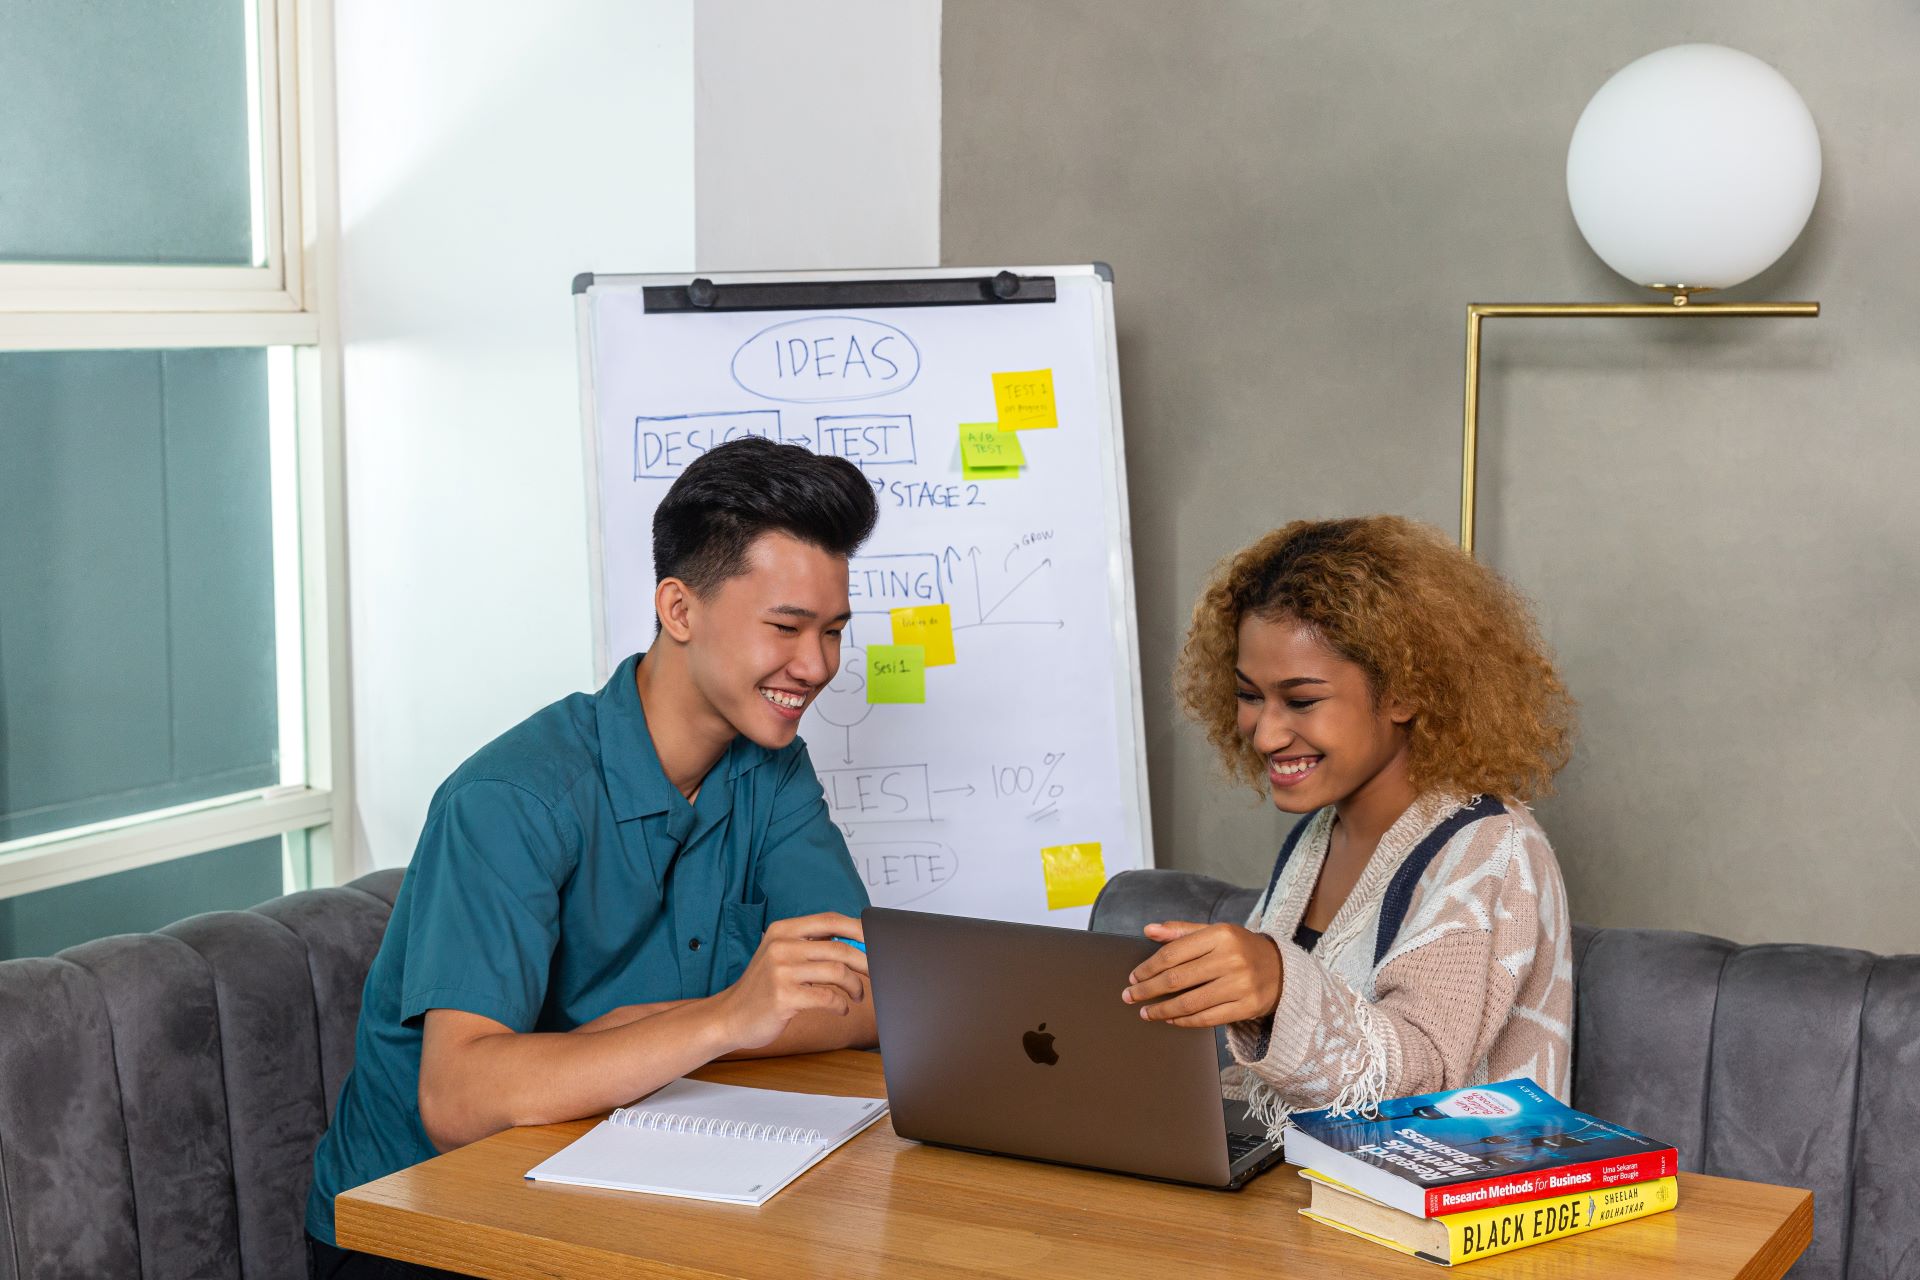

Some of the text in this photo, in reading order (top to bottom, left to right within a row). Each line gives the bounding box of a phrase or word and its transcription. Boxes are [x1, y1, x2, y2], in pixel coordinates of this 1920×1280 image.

[776, 335, 898, 380] IDEAS
[1005, 384, 1036, 399] TEST
[824, 426, 900, 456] TEST
[890, 481, 985, 507] STAGE 2
[1021, 529, 1054, 546] GROW
[848, 569, 932, 599] ETING
[899, 659, 911, 673] 1
[991, 752, 1066, 806] 100%
[853, 855, 944, 887] LETE
[1517, 1085, 1544, 1103] WILEY
[1383, 1139, 1476, 1177] Methods
[1394, 1128, 1483, 1164] Business
[1358, 1144, 1449, 1181] Research
[1617, 1163, 1638, 1173] Sekaran
[1442, 1172, 1592, 1206] Research Methods for Business
[1602, 1174, 1619, 1183] Roger
[1600, 1201, 1645, 1221] KOLHATKAR
[1604, 1188, 1638, 1205] SHEELAH
[1463, 1200, 1581, 1255] BLACK EDGE
